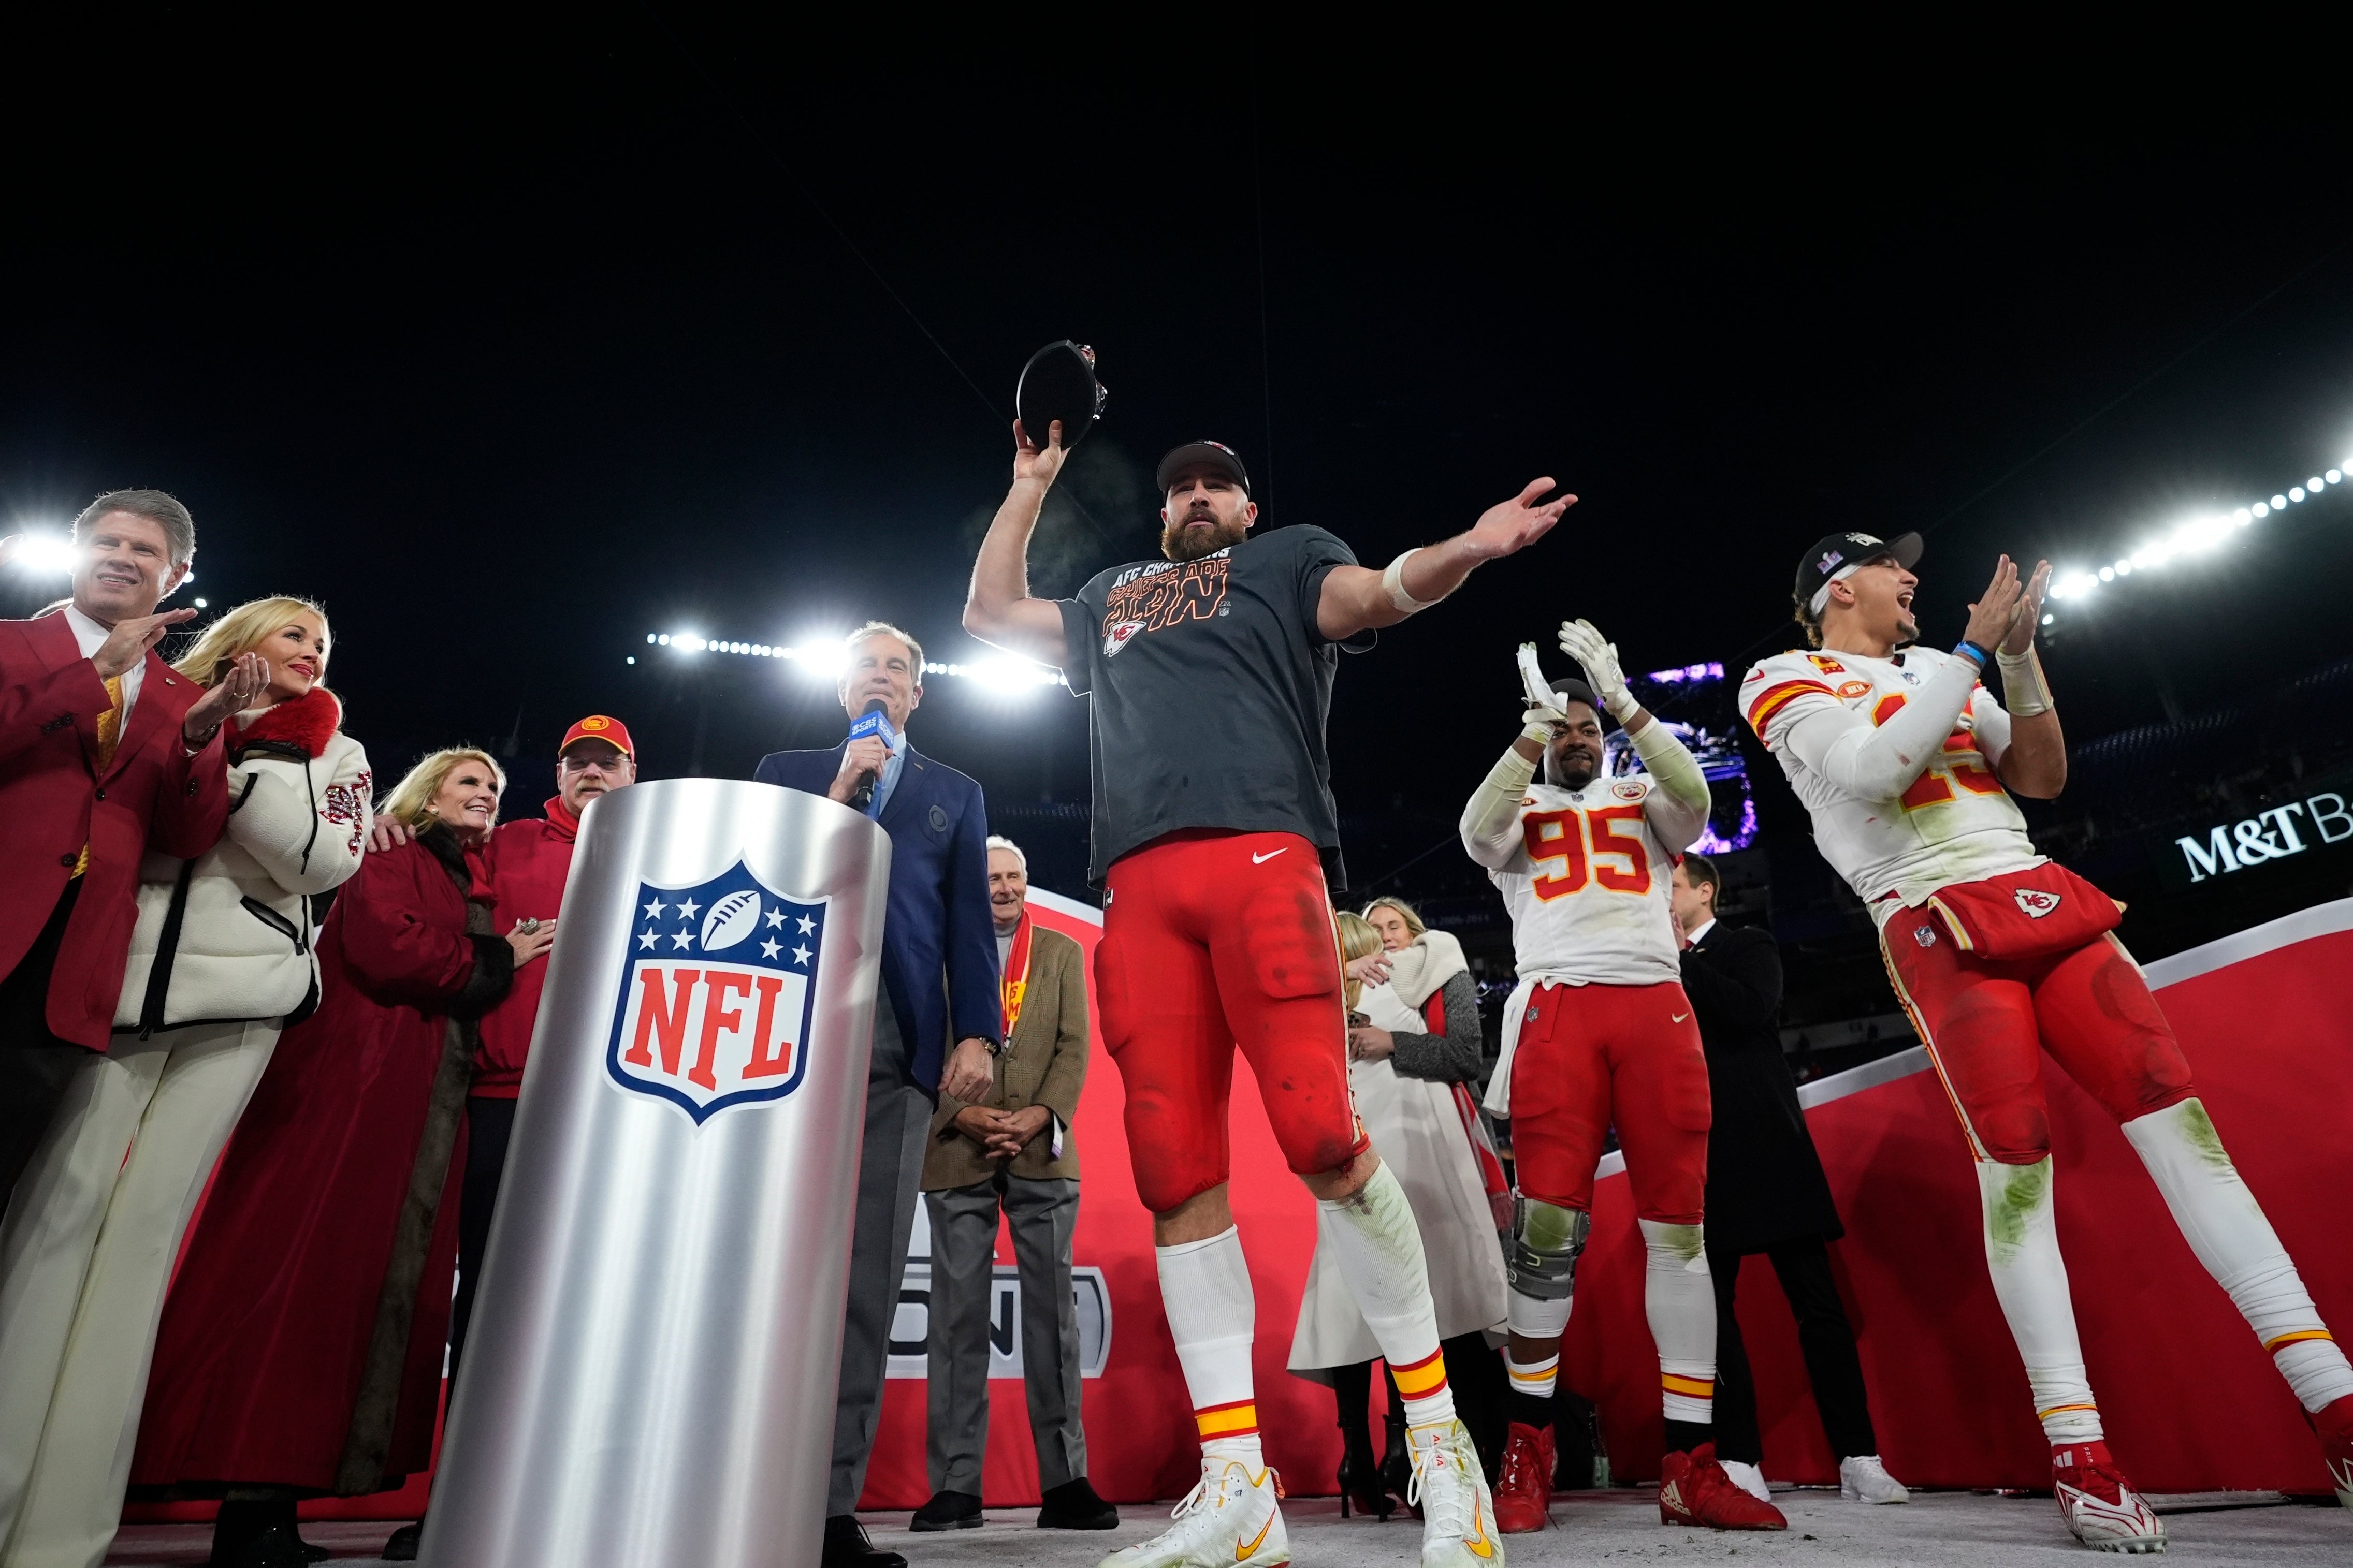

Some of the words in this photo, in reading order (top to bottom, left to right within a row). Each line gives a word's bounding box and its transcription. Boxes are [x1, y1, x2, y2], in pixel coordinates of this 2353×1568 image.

[1111, 567, 1142, 589] AFC
[851, 723, 877, 736] SPORTS
[860, 716, 877, 728] CBS
[2175, 802, 2308, 883] M&T
[2306, 793, 2353, 843] B
[1522, 804, 1652, 904] 95
[2022, 893, 2052, 909] KC
[624, 968, 792, 1092] NFL
[1660, 1491, 1691, 1516] adidas
